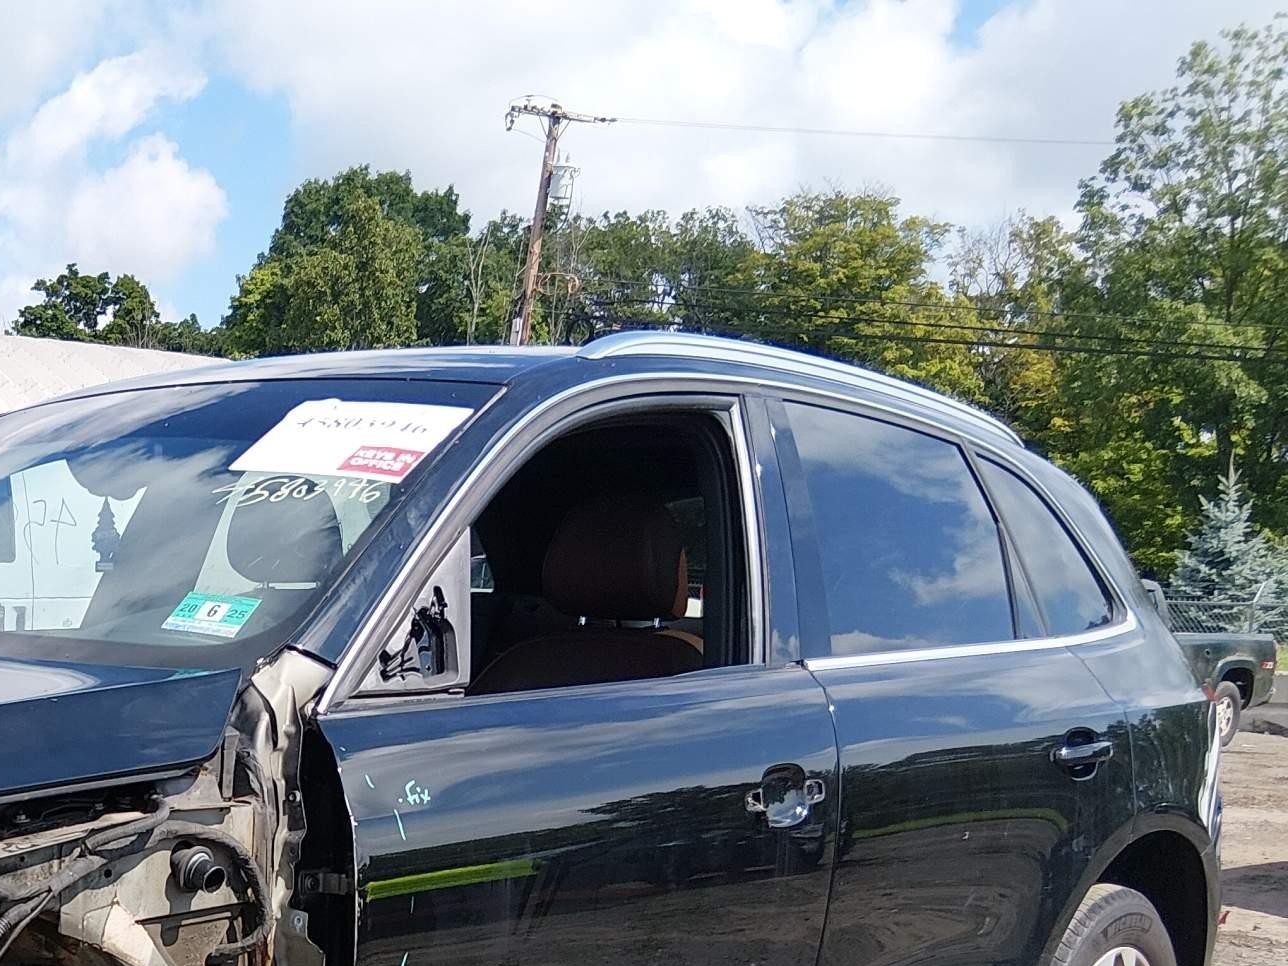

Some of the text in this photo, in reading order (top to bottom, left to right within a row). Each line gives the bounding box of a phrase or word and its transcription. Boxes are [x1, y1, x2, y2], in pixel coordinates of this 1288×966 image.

[354, 449, 417, 464] KEYS IN
[350, 457, 405, 472] OFFICE
[206, 604, 221, 618] 6
[226, 608, 249, 620] 25
